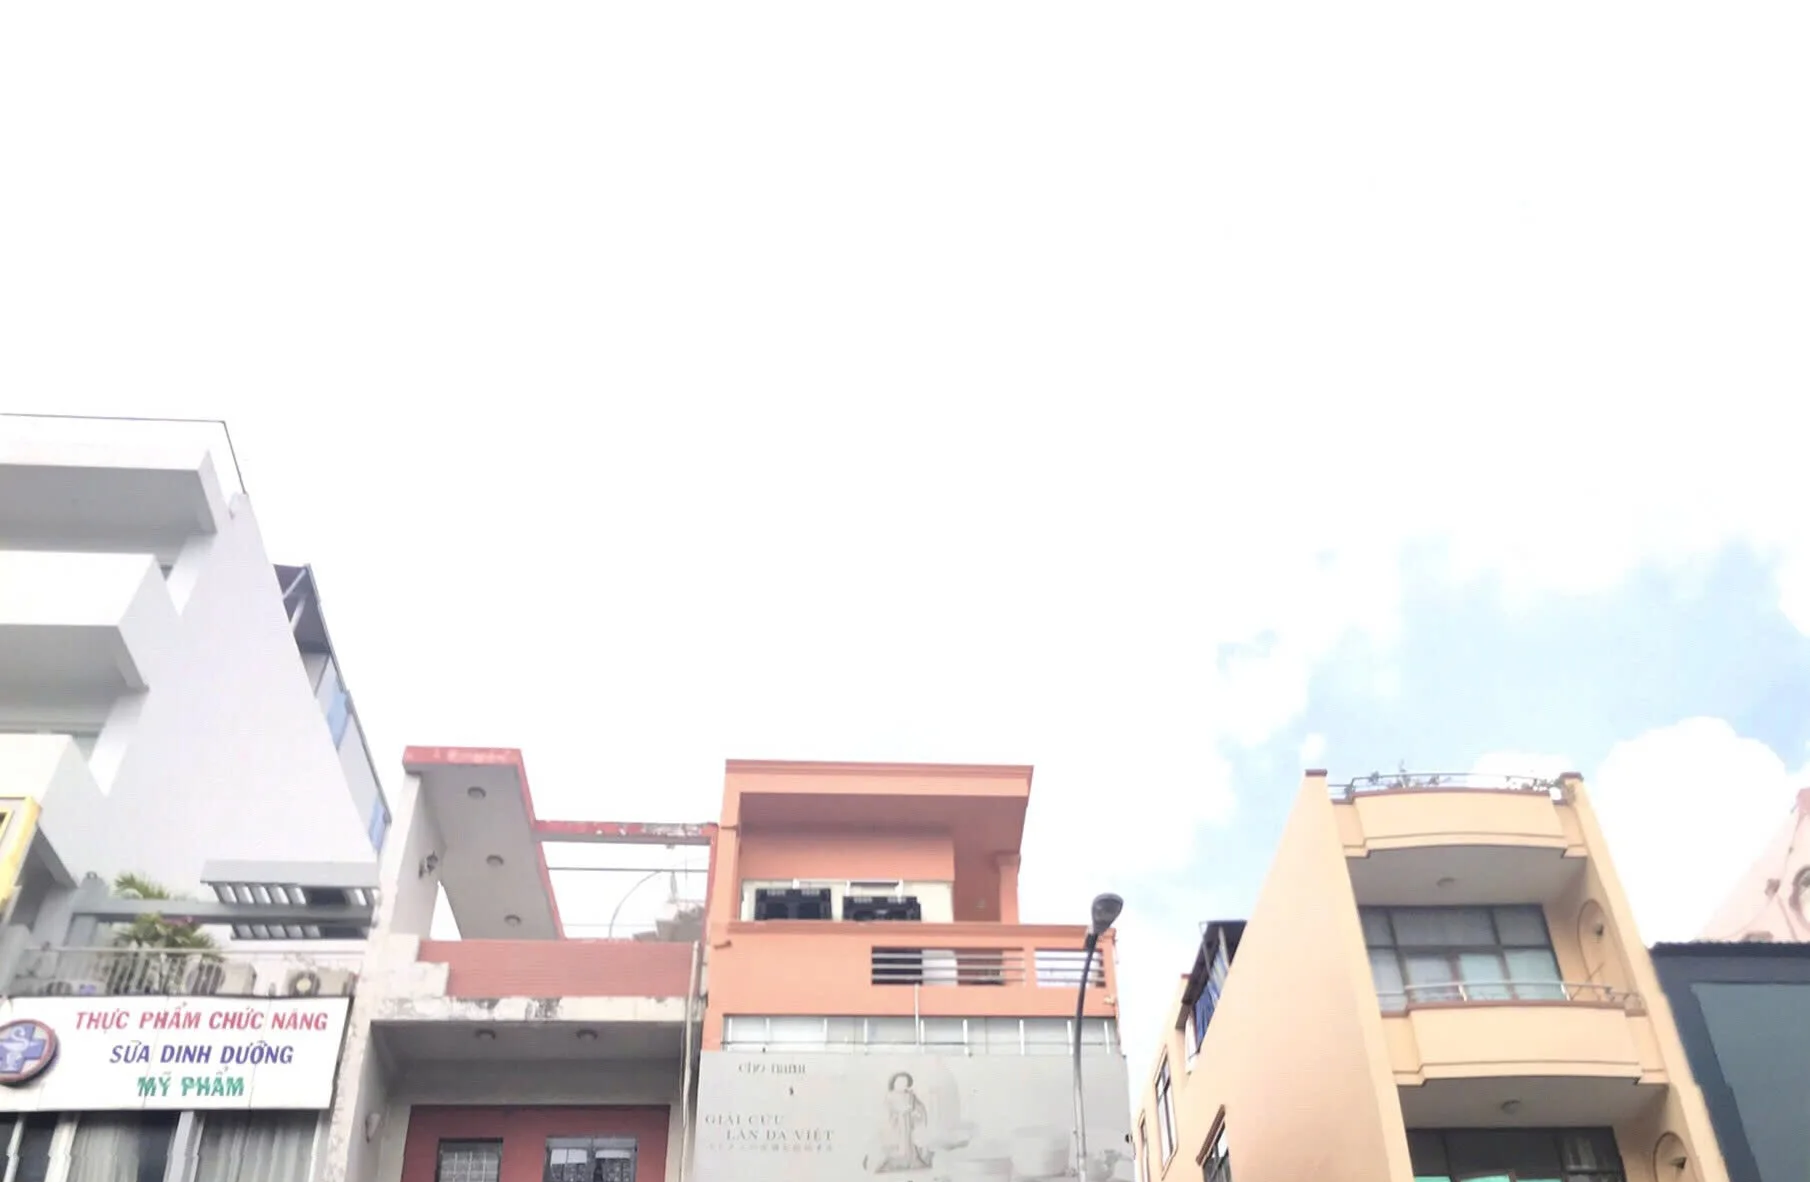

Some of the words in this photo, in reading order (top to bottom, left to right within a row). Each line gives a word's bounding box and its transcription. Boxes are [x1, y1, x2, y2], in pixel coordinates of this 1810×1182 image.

[76, 1008, 130, 1034] THỰC
[139, 1001, 201, 1030] PHẨM
[208, 1005, 264, 1030] CHỨC
[160, 1044, 212, 1064] DINH
[181, 1065, 245, 1097] PHẨM
